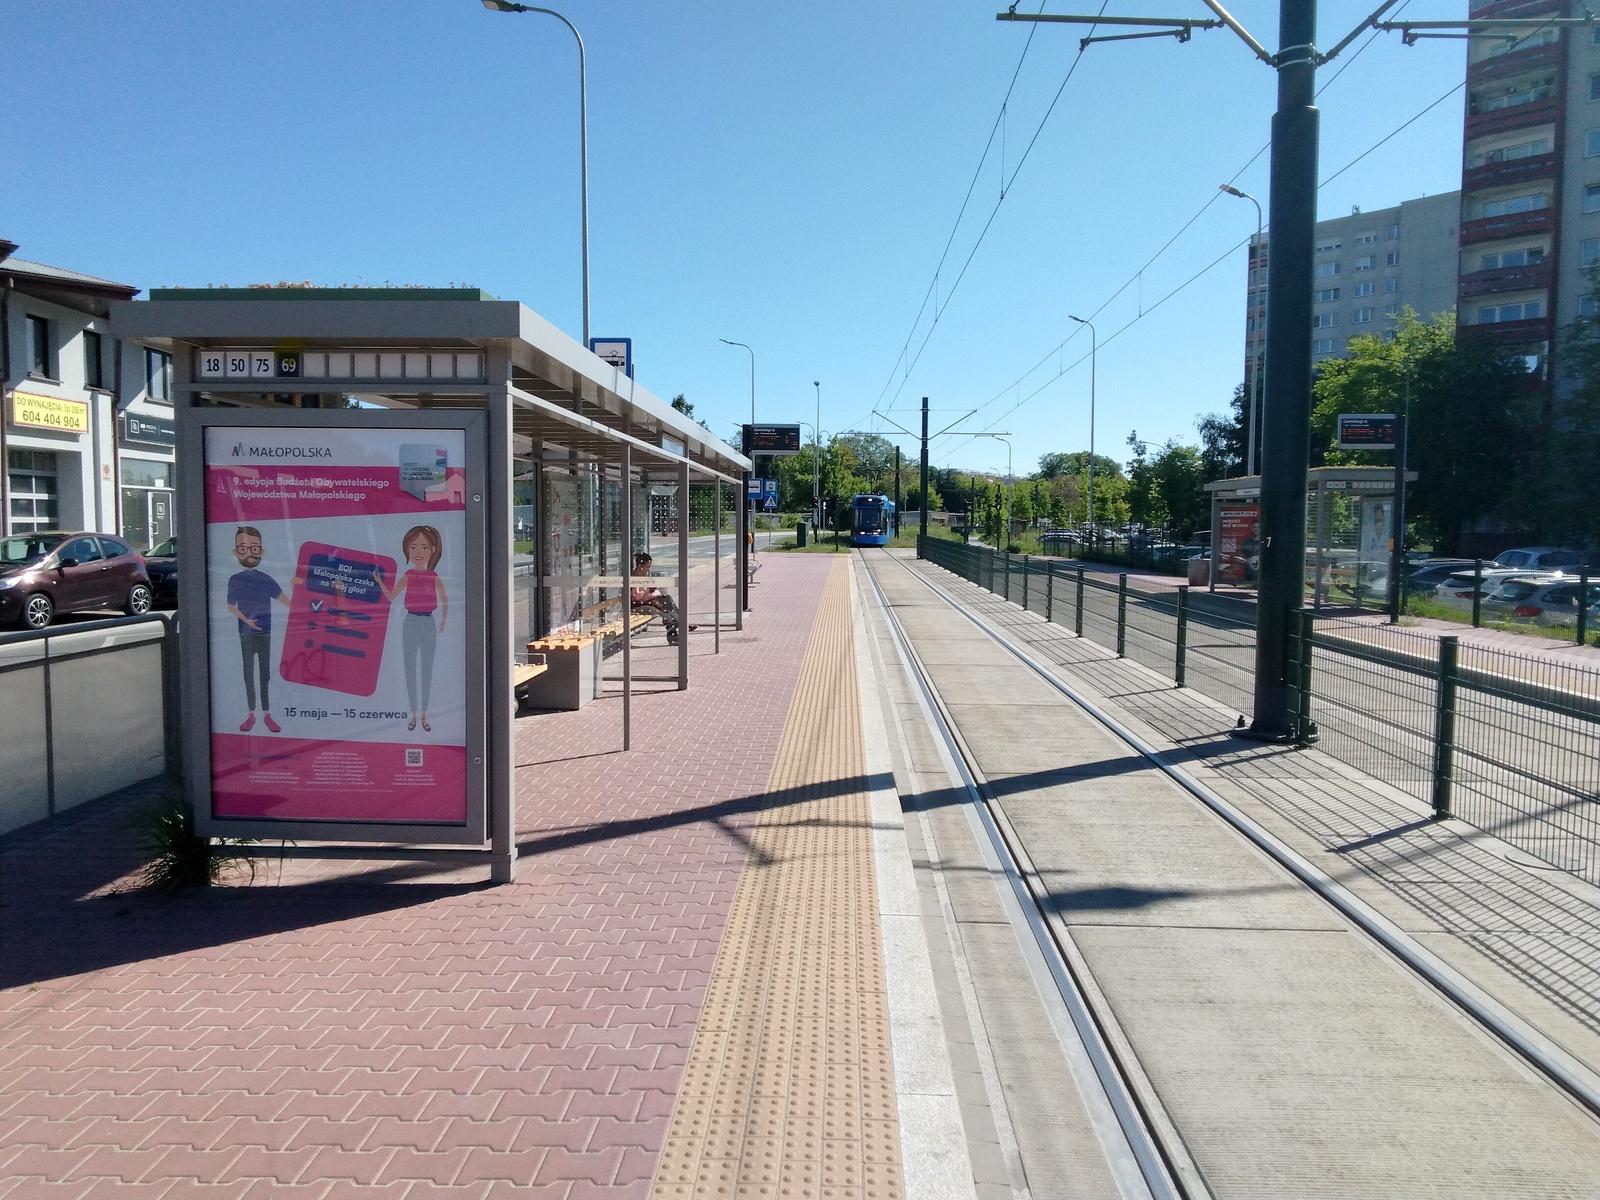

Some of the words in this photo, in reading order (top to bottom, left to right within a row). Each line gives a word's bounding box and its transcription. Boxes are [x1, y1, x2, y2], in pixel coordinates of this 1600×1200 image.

[206, 358, 220, 372] 18
[231, 358, 245, 372] 50
[256, 358, 270, 372] 75
[281, 358, 297, 372] 69
[16, 396, 26, 406] DO
[22, 410, 41, 423] 604
[44, 413, 61, 426] 404
[63, 416, 80, 428] 904
[249, 446, 333, 458] MAŁOPOLSKA
[232, 476, 242, 486] 9.
[244, 476, 274, 488] edycja
[315, 477, 390, 489] Obywatelskiego
[233, 489, 297, 501] Województwa
[299, 490, 367, 502] Małopolskiego
[284, 707, 297, 718] 15
[300, 708, 328, 720] maja
[344, 708, 357, 719] 15
[359, 710, 408, 719] czerwca
